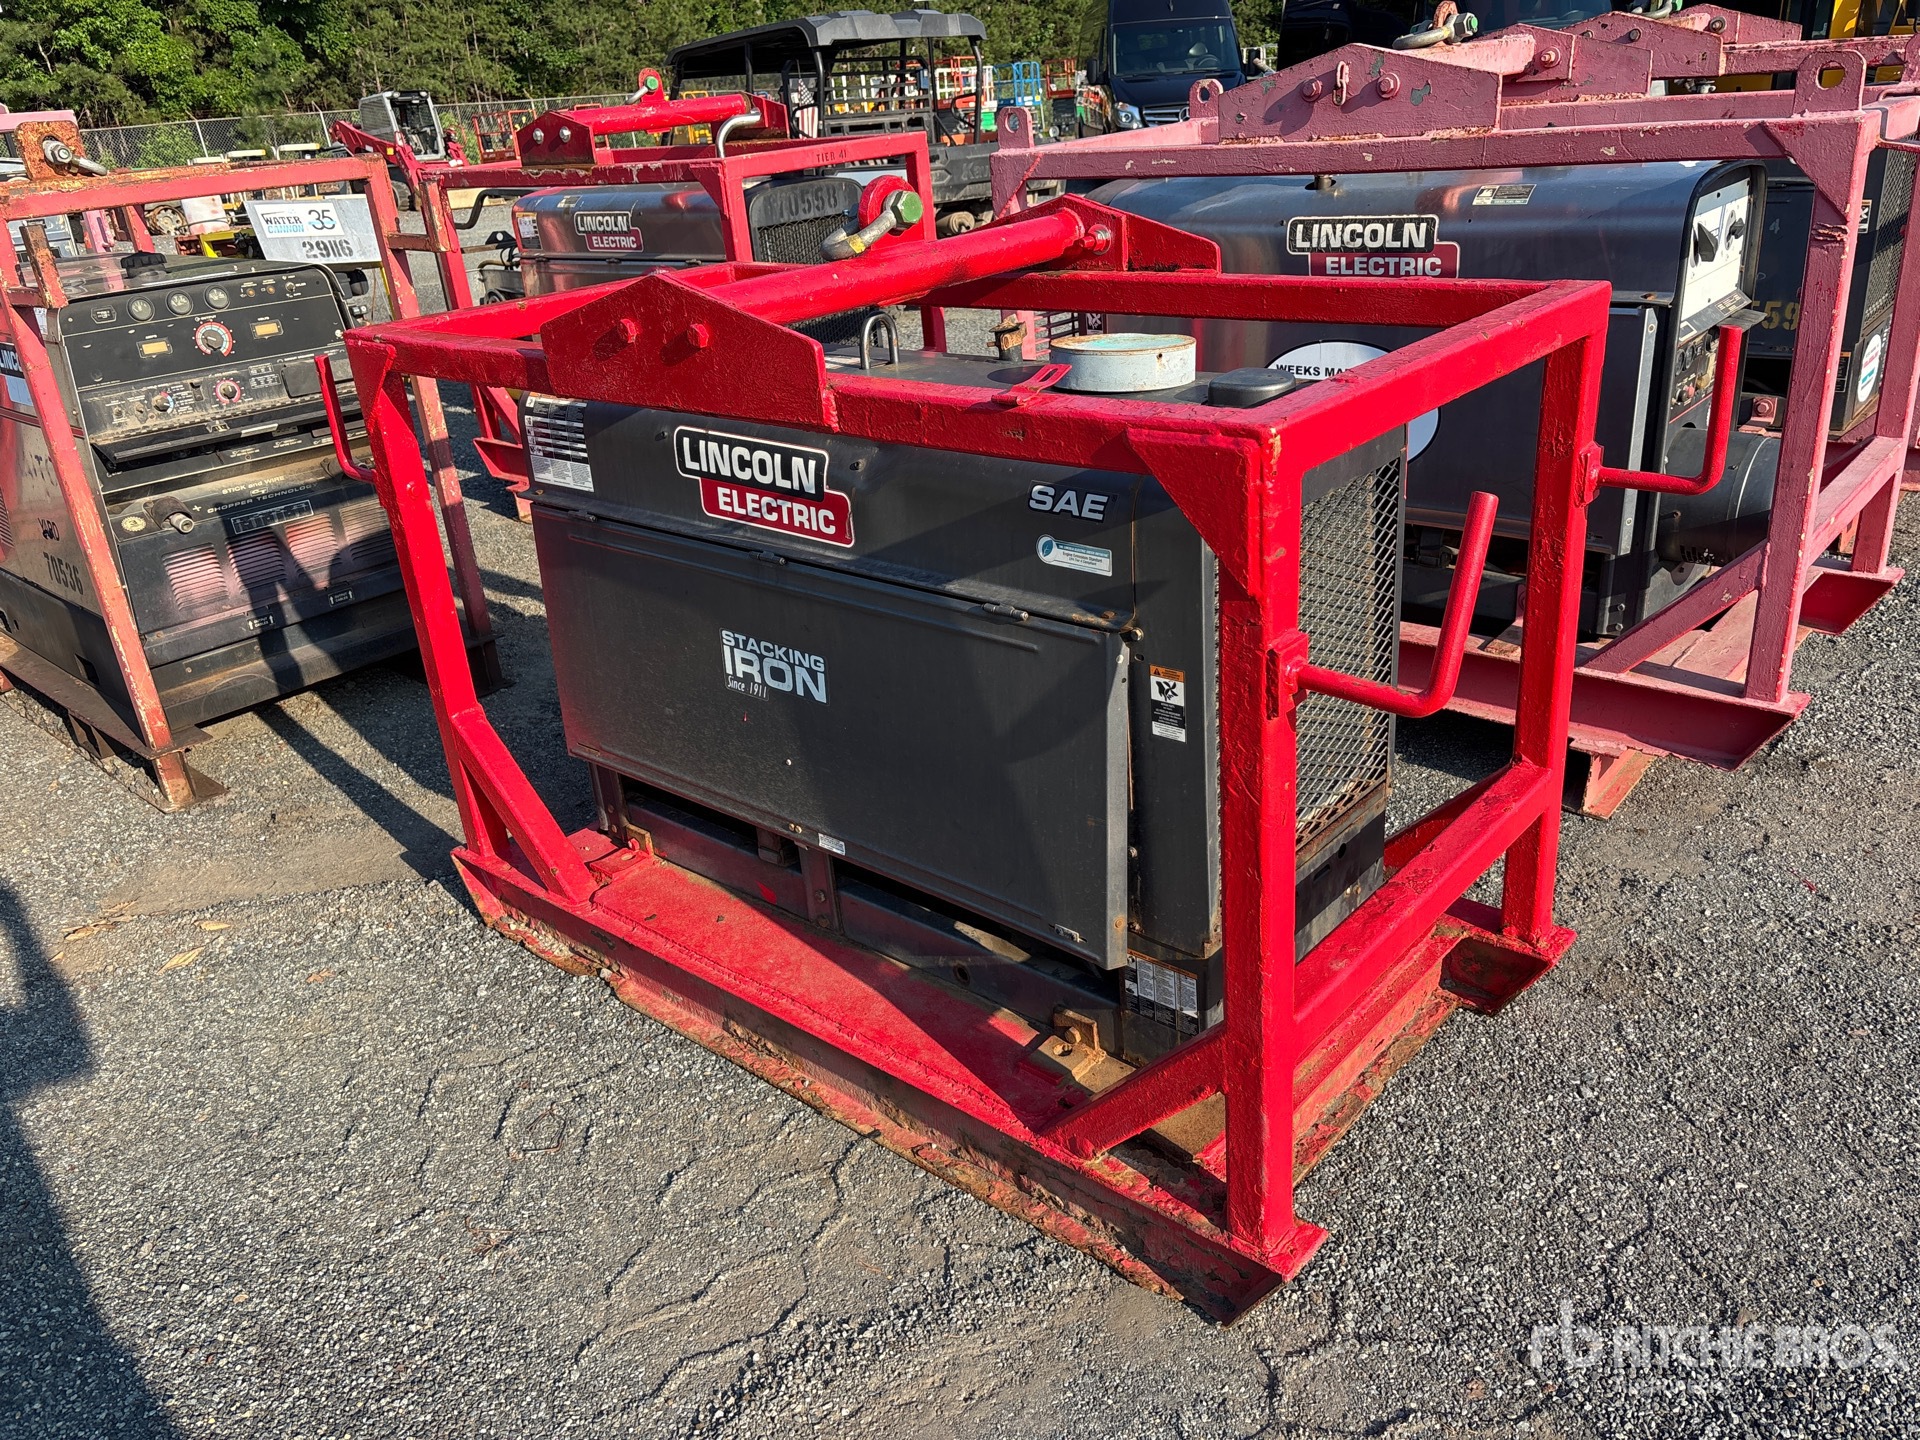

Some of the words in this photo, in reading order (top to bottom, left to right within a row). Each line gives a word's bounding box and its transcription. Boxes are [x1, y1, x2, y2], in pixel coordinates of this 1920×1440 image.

[816, 151, 836, 163] TIER
[263, 215, 302, 225] WATER
[267, 224, 305, 234] CANNON
[308, 209, 337, 230] 35
[577, 215, 628, 232] LINCOLN
[592, 236, 637, 249] ELECTRIC
[1295, 222, 1428, 249] LINCOLN
[302, 239, 354, 259] 29116
[1325, 256, 1442, 276] ELECTRIC
[1276, 364, 1320, 376] WEEKS
[683, 436, 817, 495] LINCOLN
[222, 484, 247, 495] STICK
[248, 480, 263, 489] and
[264, 475, 285, 485] WIRE
[207, 498, 253, 514] CHOPPER
[256, 482, 319, 502] TECHNOLOGY
[1029, 484, 1109, 521] SAE
[717, 486, 836, 535] ELECTRIC
[43, 551, 84, 596] 70536
[721, 629, 825, 672] STACKING
[723, 645, 828, 704] IRON
[727, 674, 746, 692] Since
[749, 682, 767, 699] 1911
